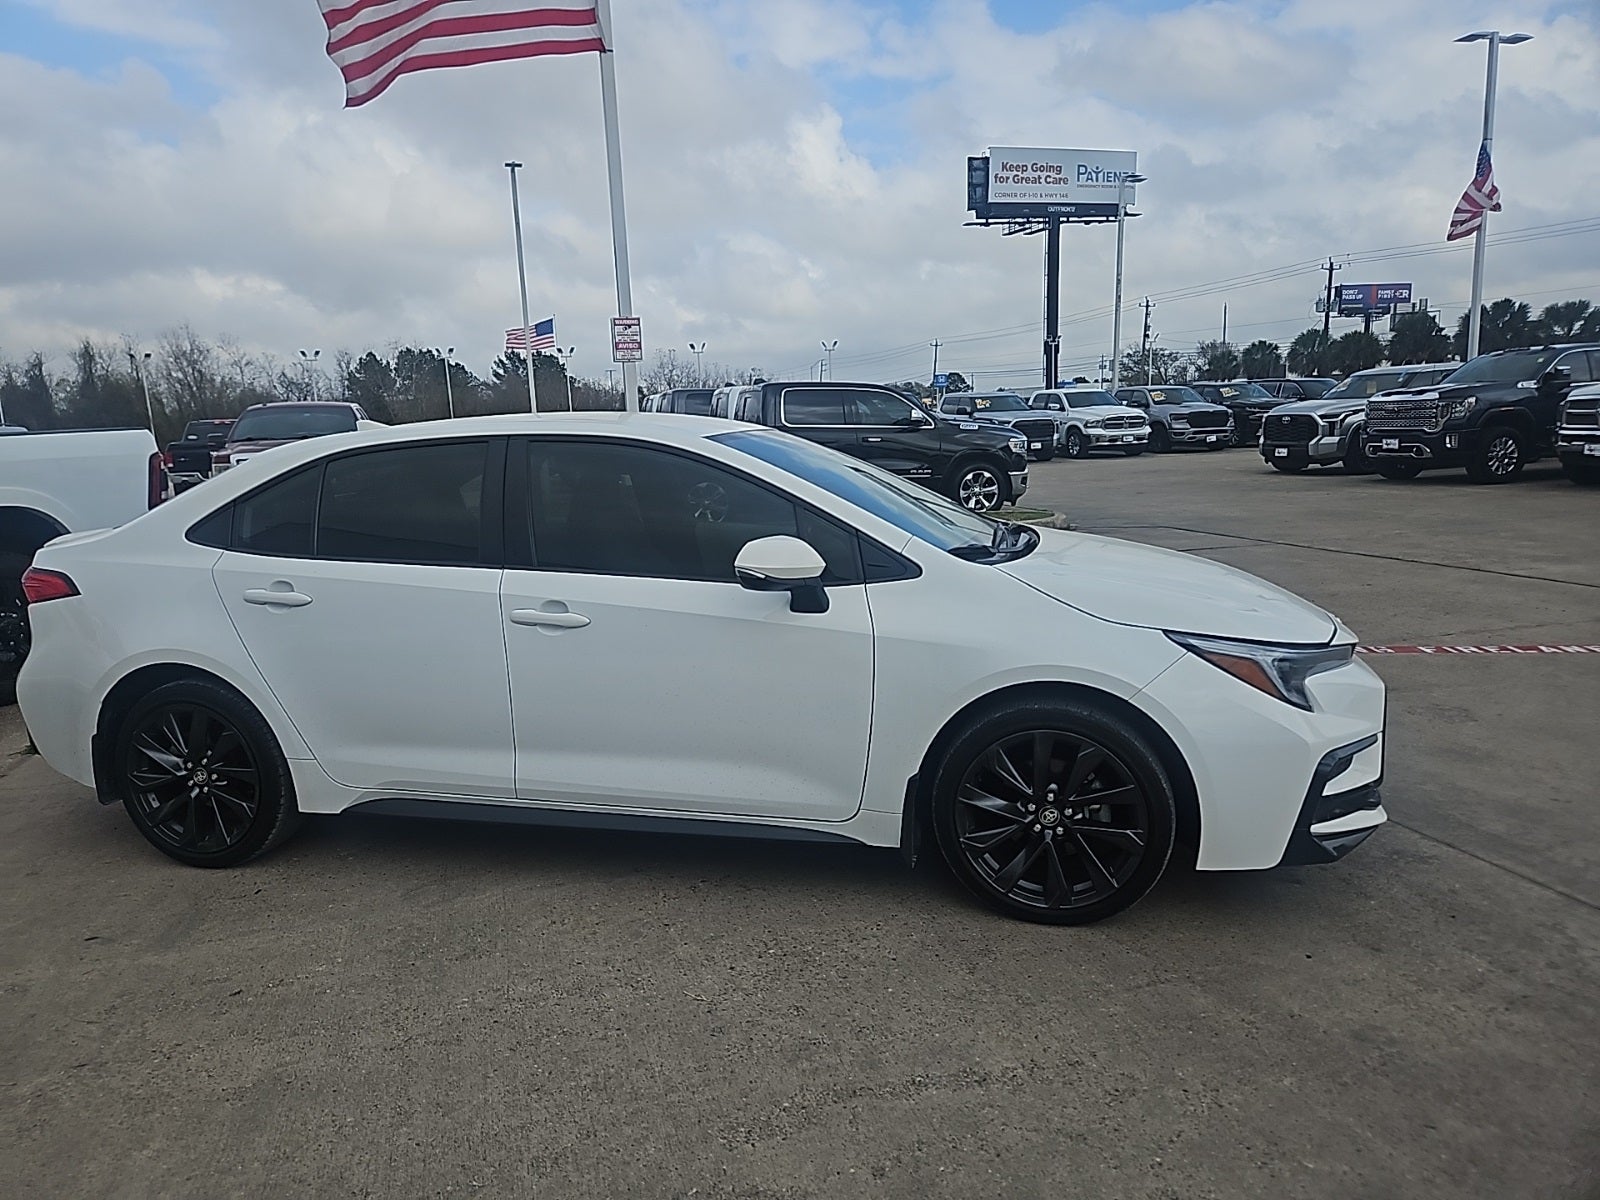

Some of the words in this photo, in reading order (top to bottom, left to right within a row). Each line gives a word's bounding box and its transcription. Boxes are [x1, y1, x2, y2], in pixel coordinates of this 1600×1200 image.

[1001, 162, 1028, 174] Keep
[1031, 162, 1063, 175] Going
[994, 173, 1010, 184] for
[1012, 174, 1042, 185] Great
[1044, 175, 1069, 185] Care
